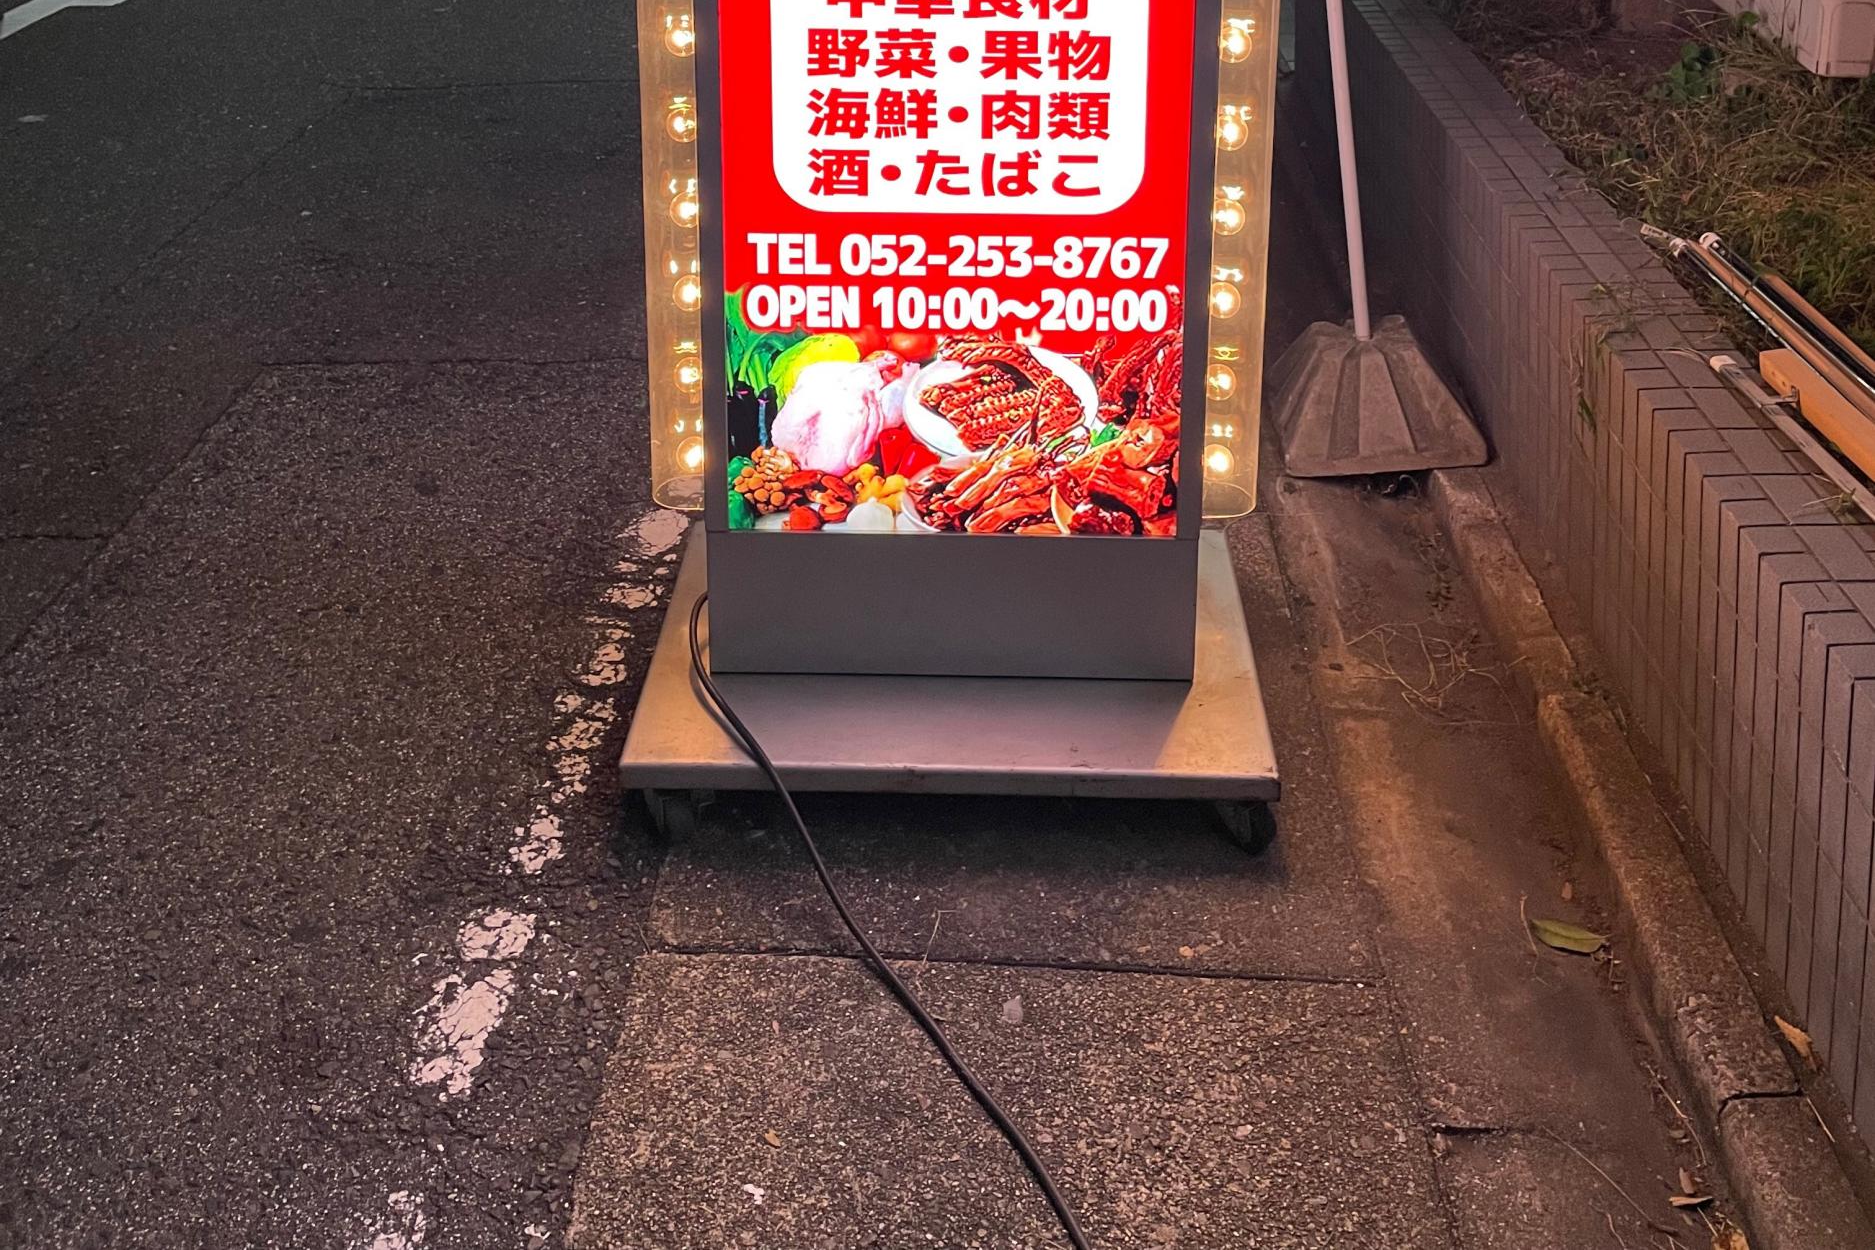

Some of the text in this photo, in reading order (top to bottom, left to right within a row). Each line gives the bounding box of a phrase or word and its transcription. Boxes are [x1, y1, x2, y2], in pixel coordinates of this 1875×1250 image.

[806, 28, 1112, 81] 野菜・果物
[807, 88, 1111, 141] 海鮮・肉類
[807, 149, 1101, 198] 酒・たばこ
[747, 233, 1169, 279] TEL 052-253-8767
[746, 285, 860, 328] OPEN
